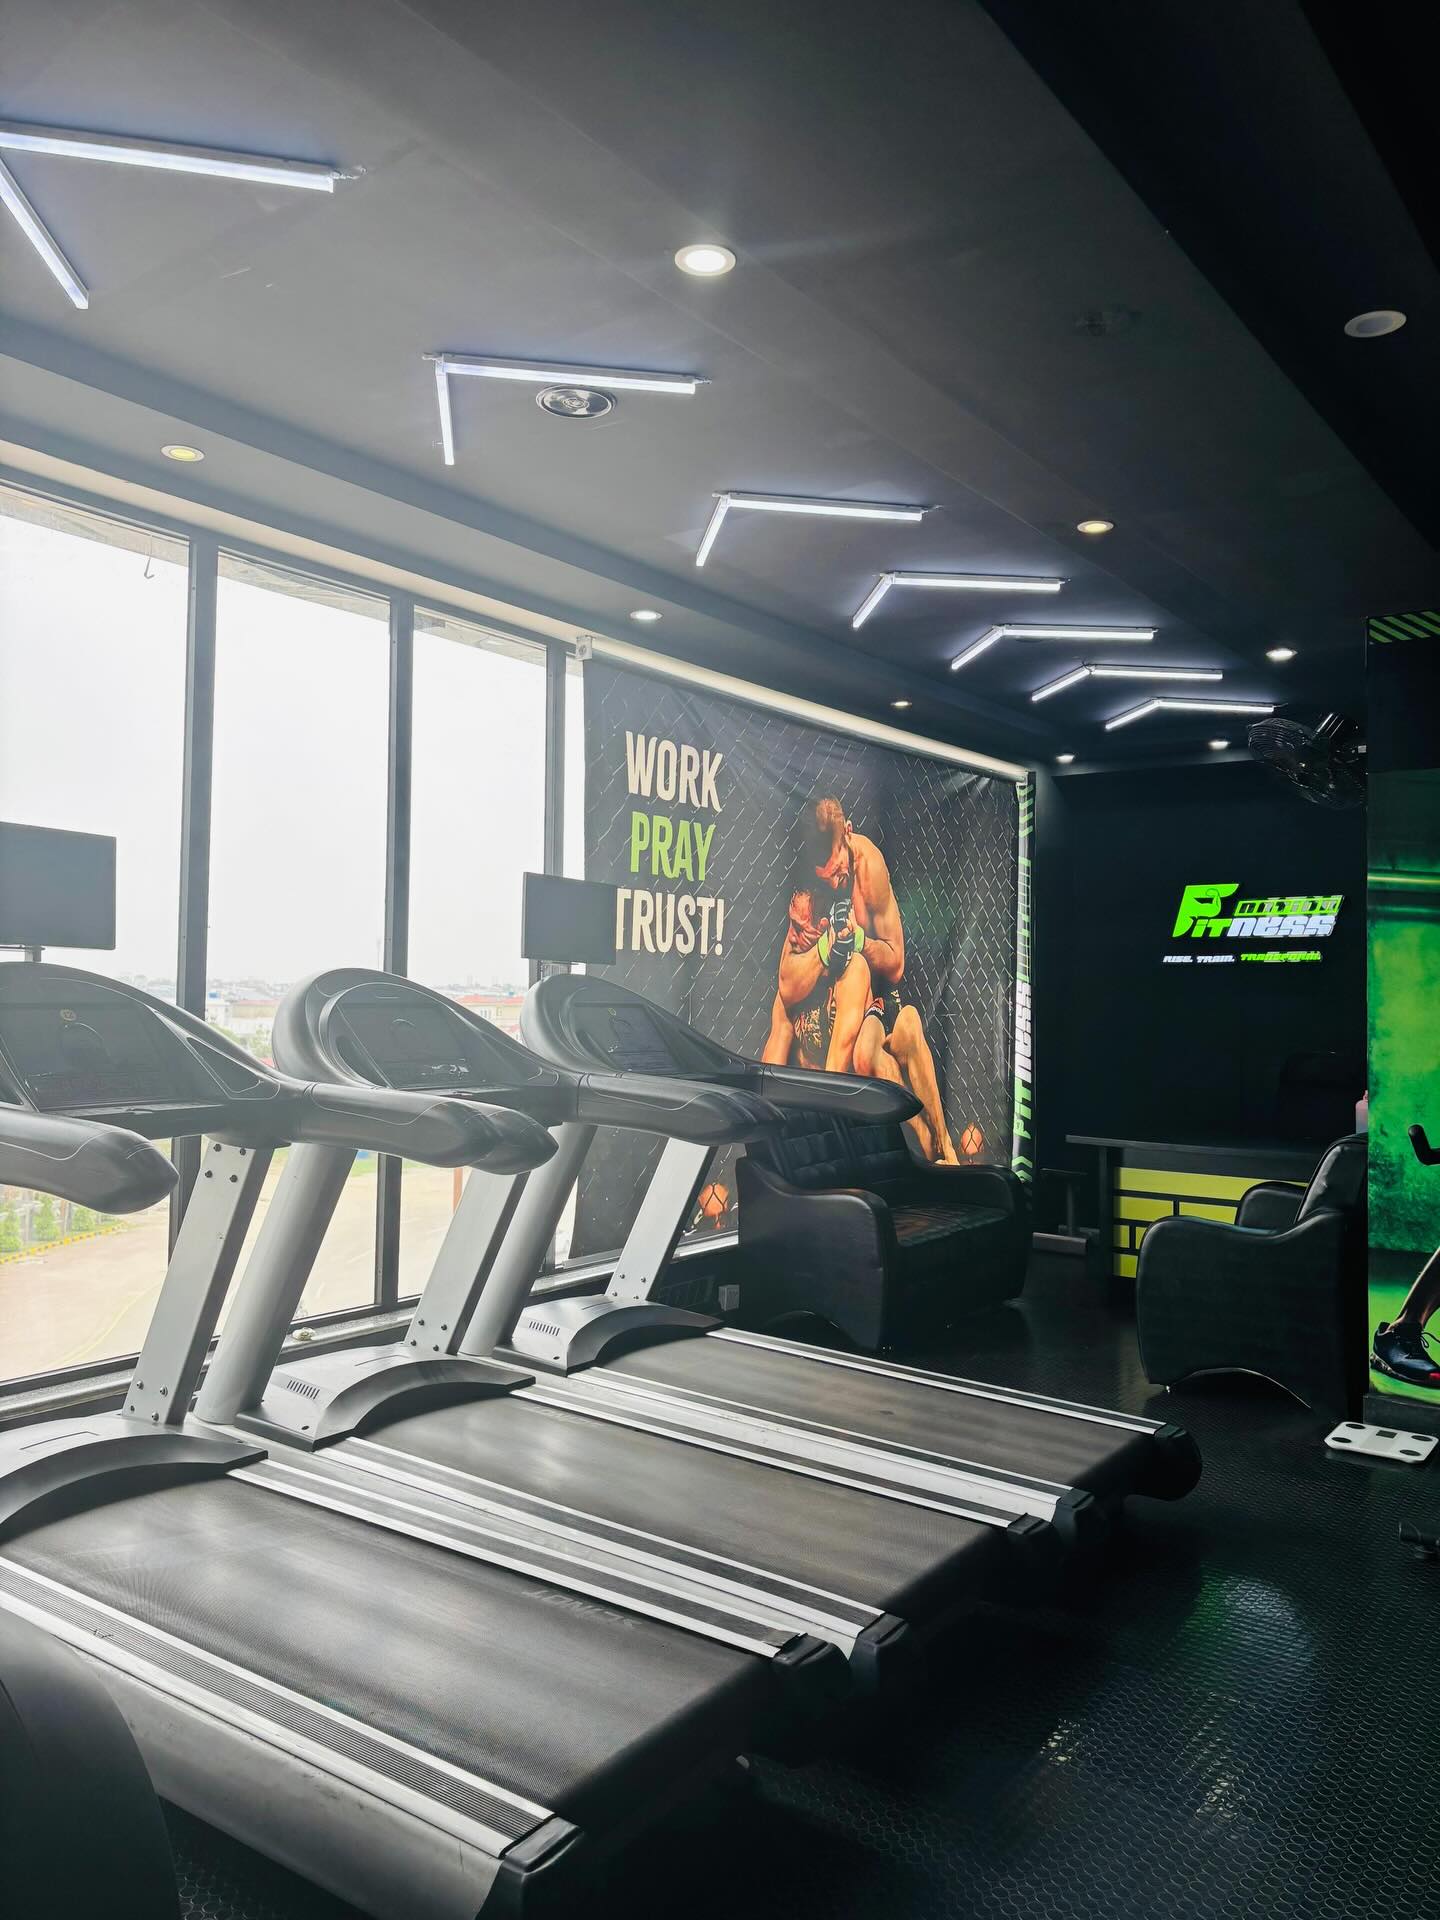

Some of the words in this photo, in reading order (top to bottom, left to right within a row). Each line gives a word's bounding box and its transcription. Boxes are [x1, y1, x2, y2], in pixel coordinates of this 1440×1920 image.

[626, 731, 723, 812] WORK
[631, 811, 717, 882] PRAY
[616, 887, 725, 956] TRUST!
